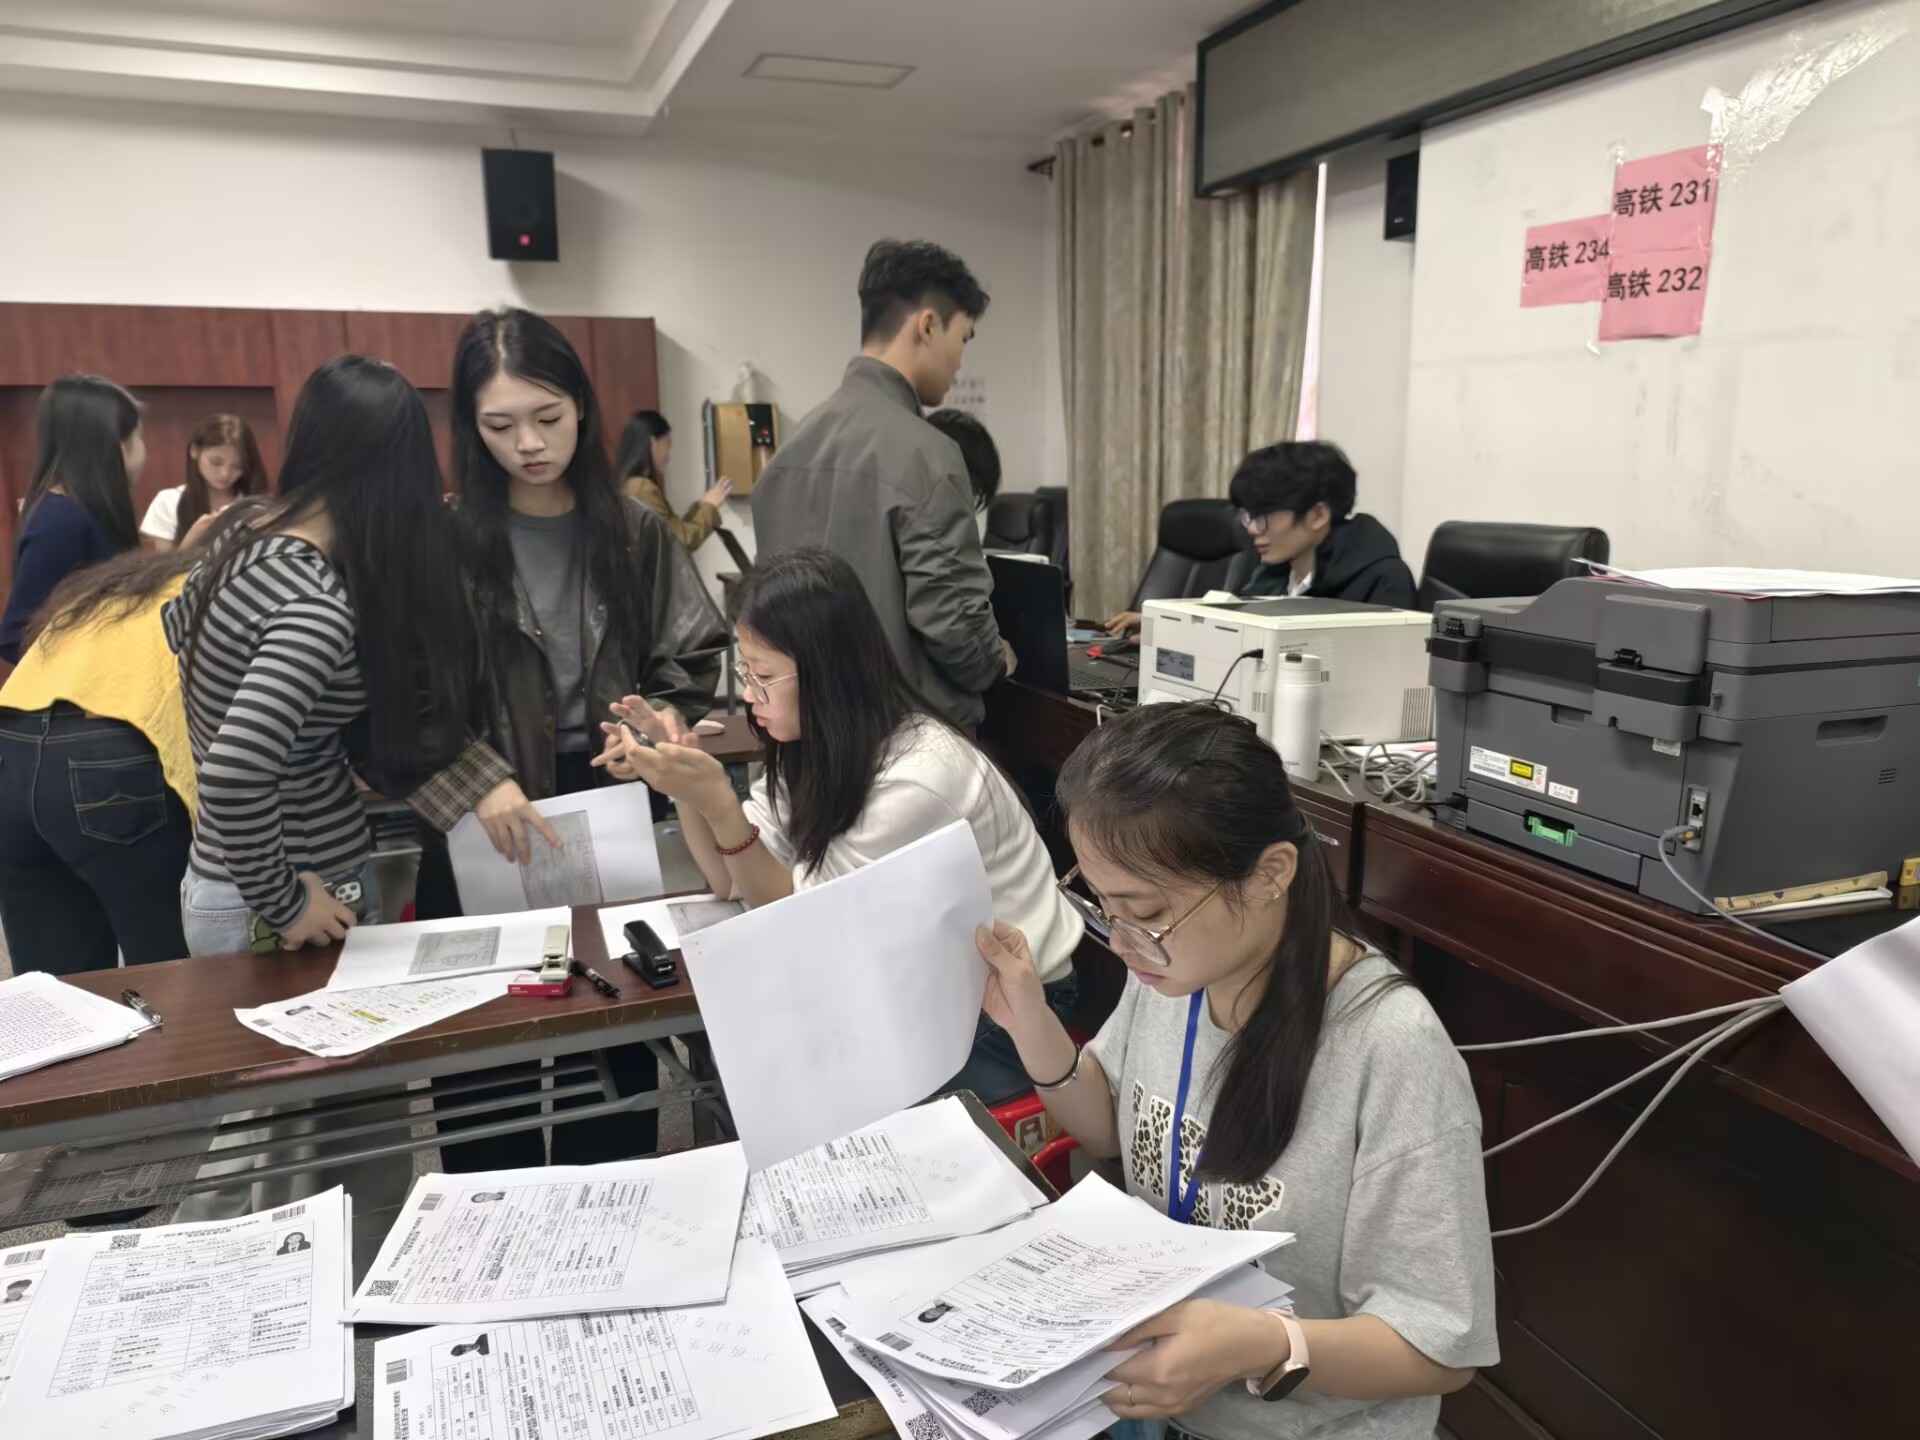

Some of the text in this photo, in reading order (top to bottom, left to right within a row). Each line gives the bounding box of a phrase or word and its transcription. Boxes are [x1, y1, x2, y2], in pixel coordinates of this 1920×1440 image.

[1614, 178, 1711, 217] 高铁 231
[1525, 238, 1610, 273] 高铁 234
[1607, 266, 1703, 301] 高铁 232
